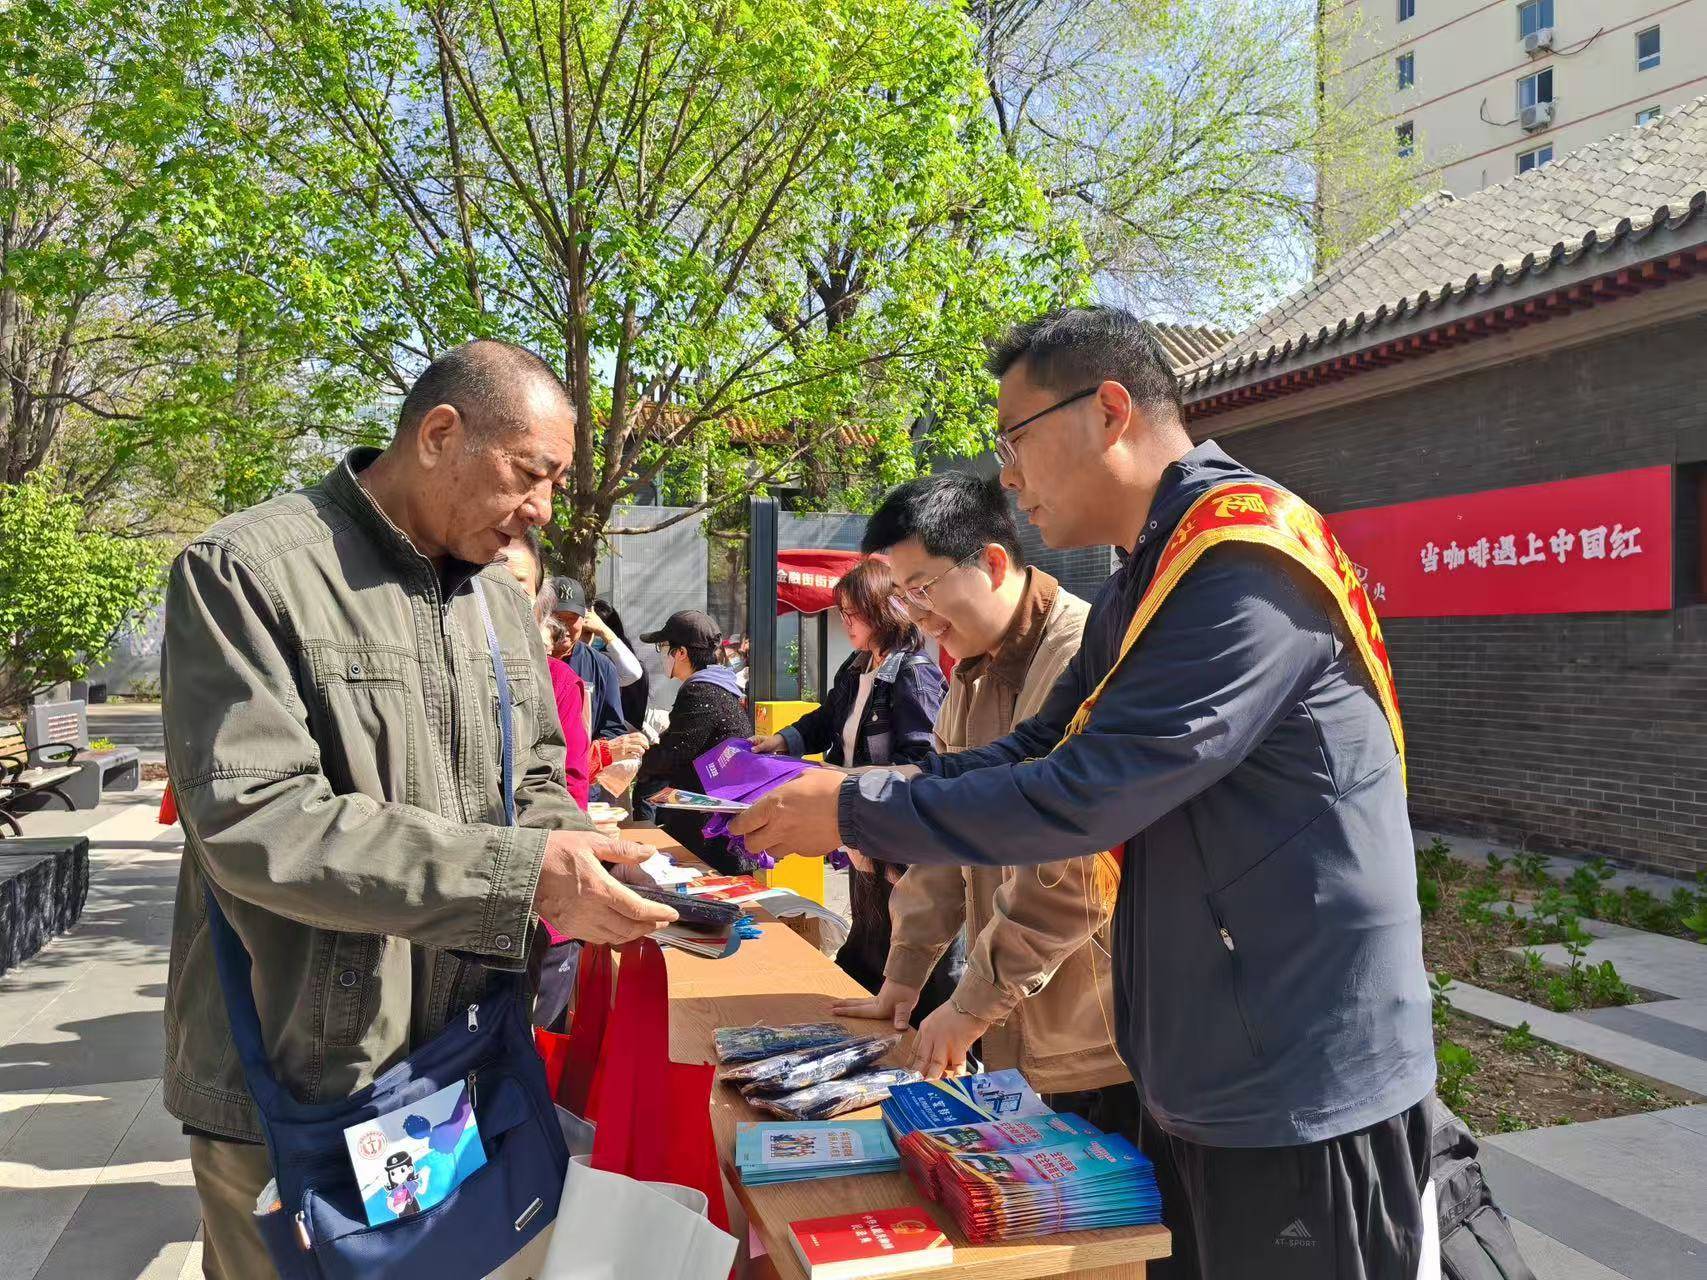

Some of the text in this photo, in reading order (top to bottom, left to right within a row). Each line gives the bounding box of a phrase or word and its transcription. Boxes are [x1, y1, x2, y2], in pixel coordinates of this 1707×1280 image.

[1420, 523, 1643, 574] 当咖啡遇上中国红
